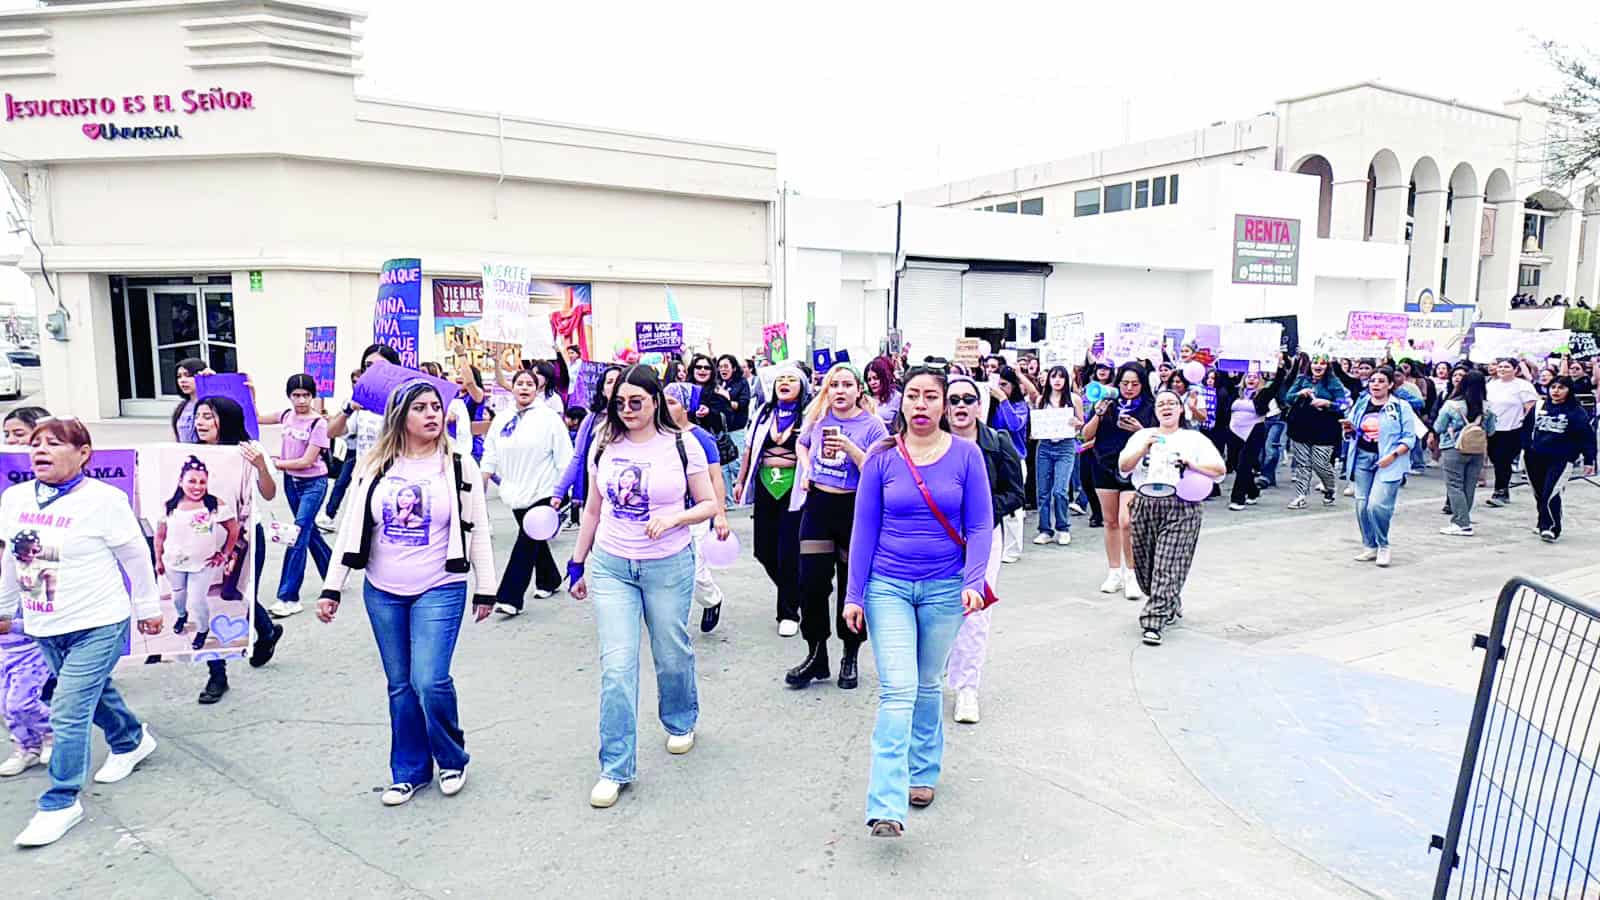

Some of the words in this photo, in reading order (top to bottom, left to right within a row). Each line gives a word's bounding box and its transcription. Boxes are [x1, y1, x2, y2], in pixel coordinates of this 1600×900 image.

[5, 92, 116, 121] JESUCRISTO
[122, 95, 146, 114] ES
[152, 95, 175, 113] EL
[181, 86, 255, 114] SEÑOR
[1245, 218, 1290, 243] RENTA
[397, 267, 420, 283] QUE
[449, 299, 461, 312] DE
[388, 337, 416, 352] QUE
